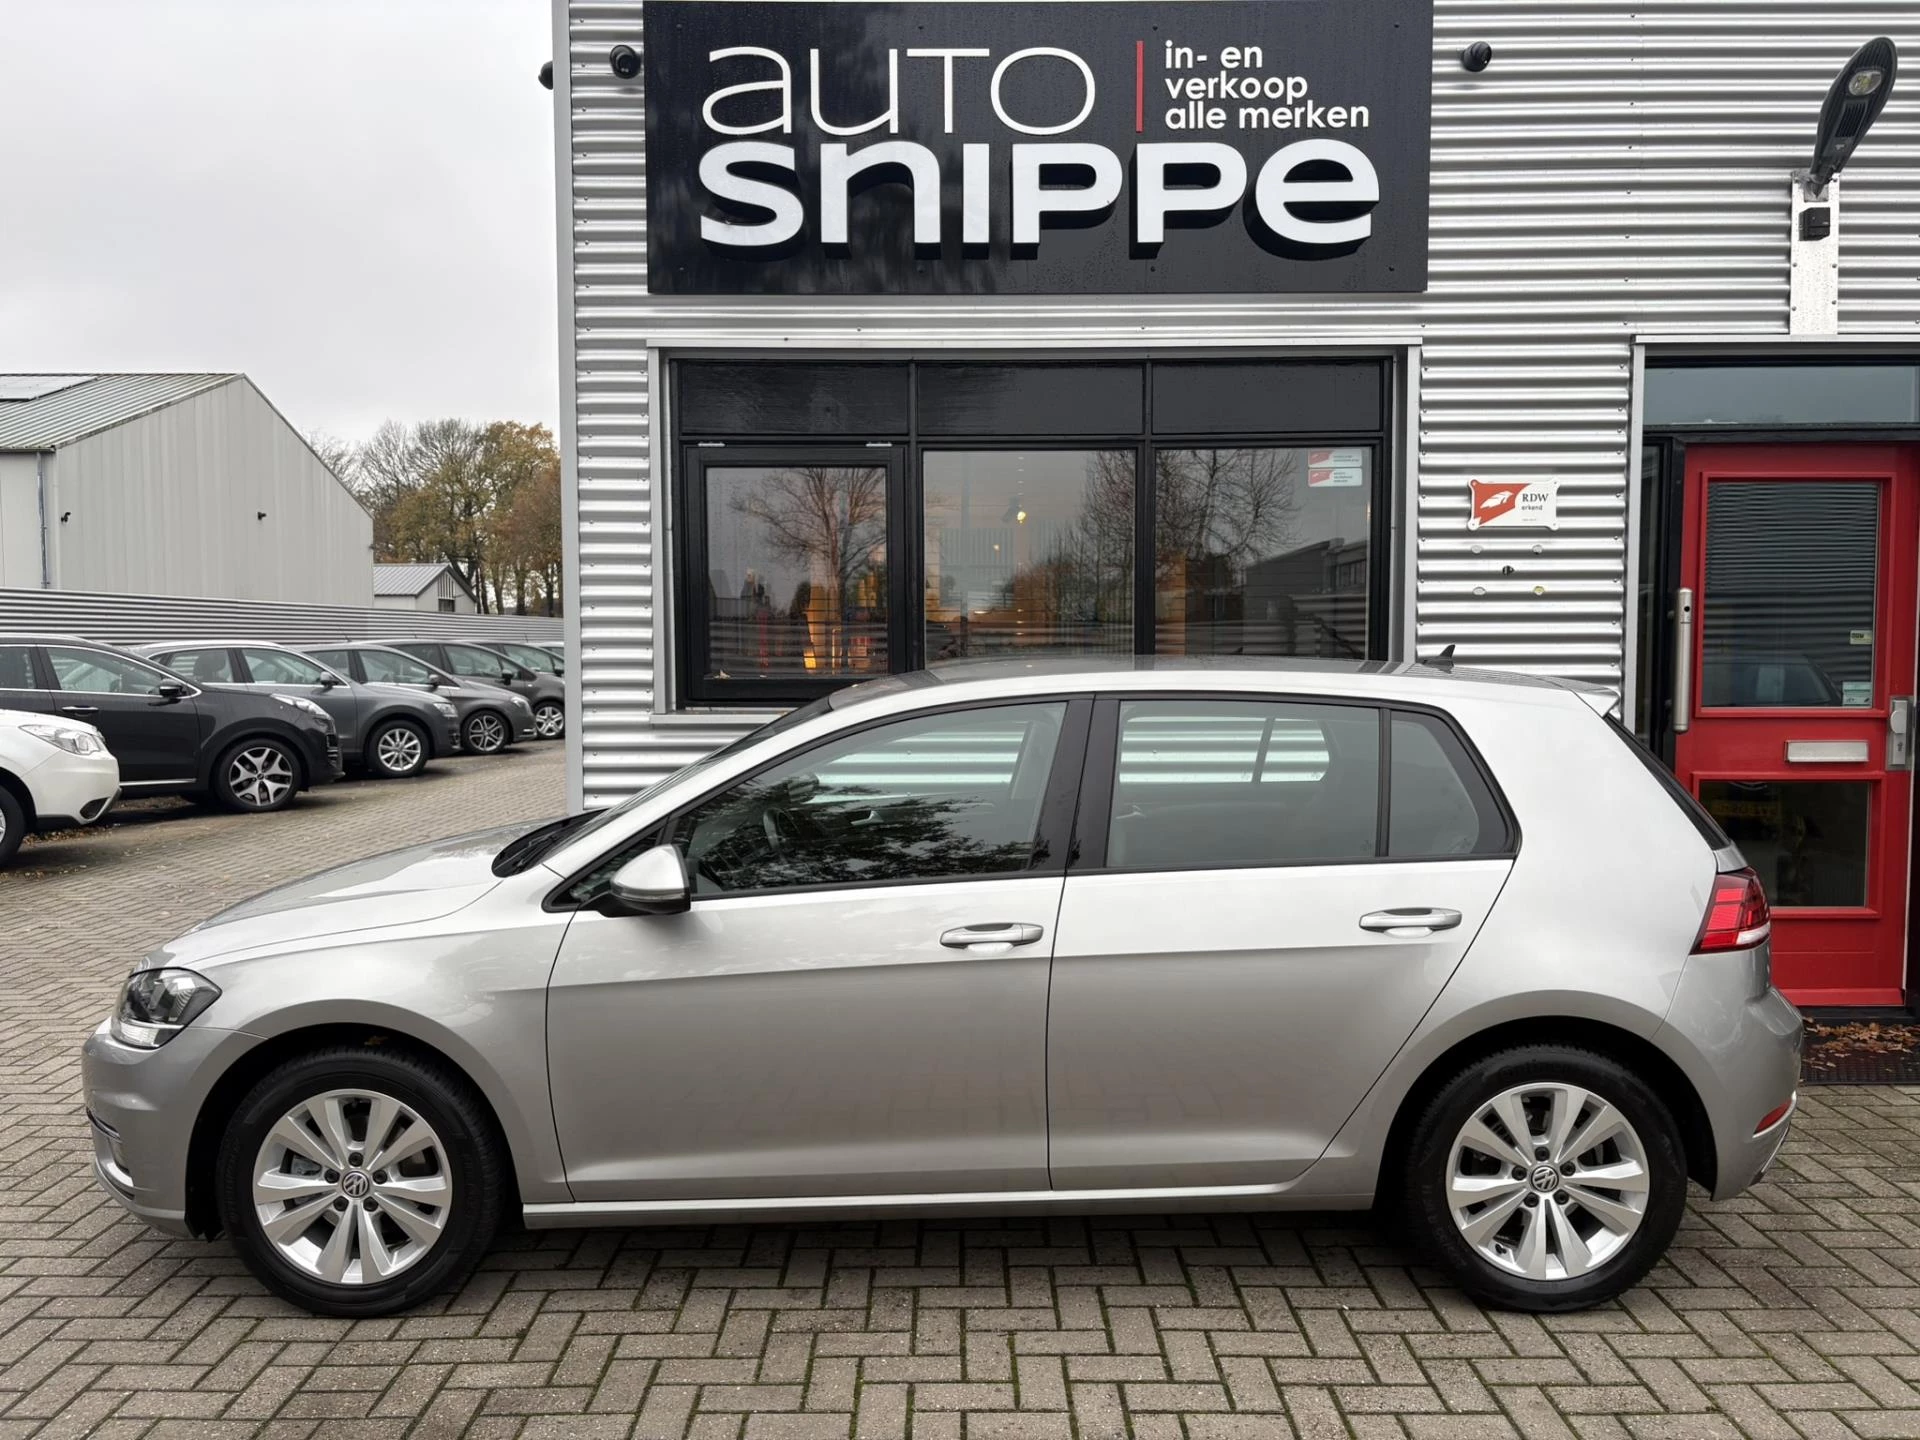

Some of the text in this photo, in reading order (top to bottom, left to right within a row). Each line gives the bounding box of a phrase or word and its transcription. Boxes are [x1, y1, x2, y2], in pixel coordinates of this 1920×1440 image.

[1165, 40, 1263, 69] in- en
[1165, 70, 1308, 105] verkoop
[1165, 99, 1370, 130] alle merken
[1522, 493, 1549, 503] RDW
